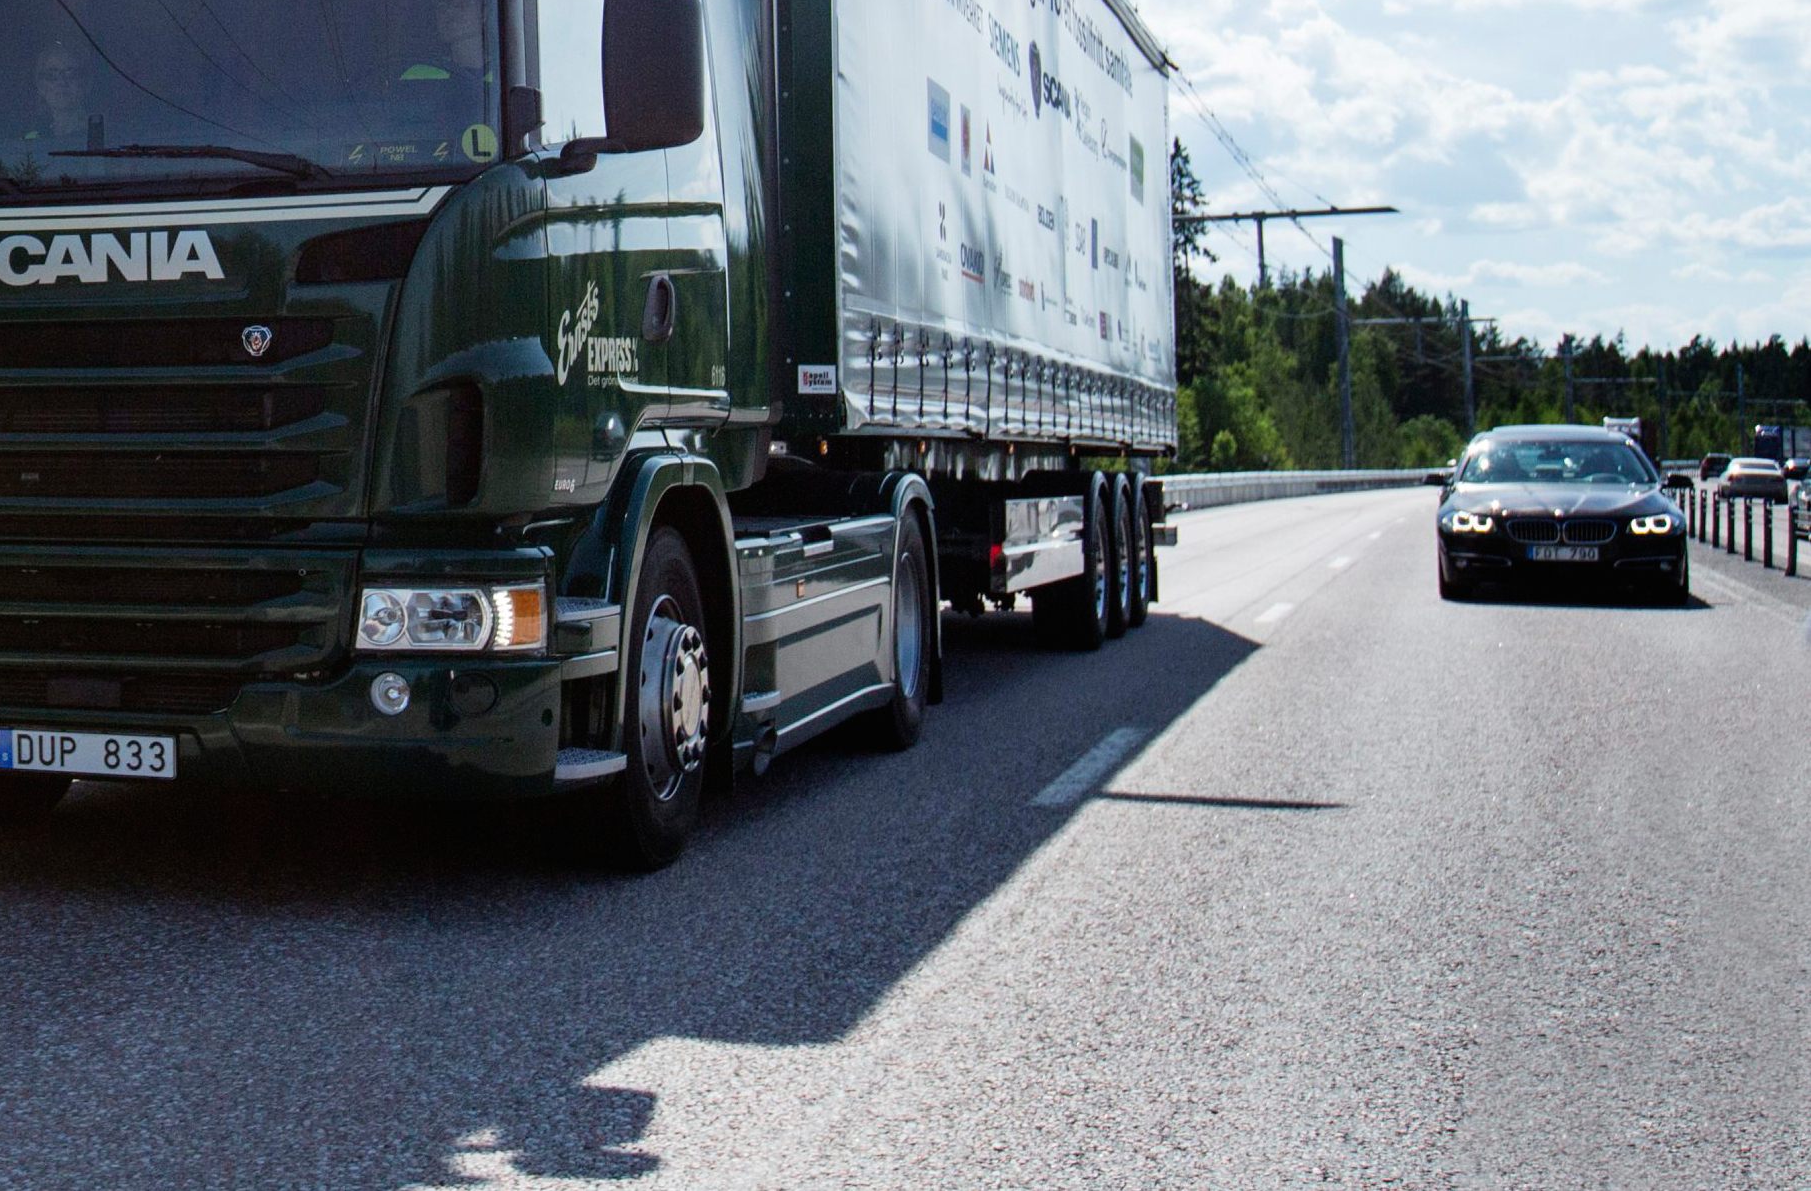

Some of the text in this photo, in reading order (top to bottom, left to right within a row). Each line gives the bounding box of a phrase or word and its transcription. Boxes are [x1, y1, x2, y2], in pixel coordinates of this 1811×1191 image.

[988, 12, 1021, 78] SIEMENS
[471, 129, 491, 157] L
[587, 336, 632, 372] EXPRESS
[16, 733, 166, 773] DUP 833
